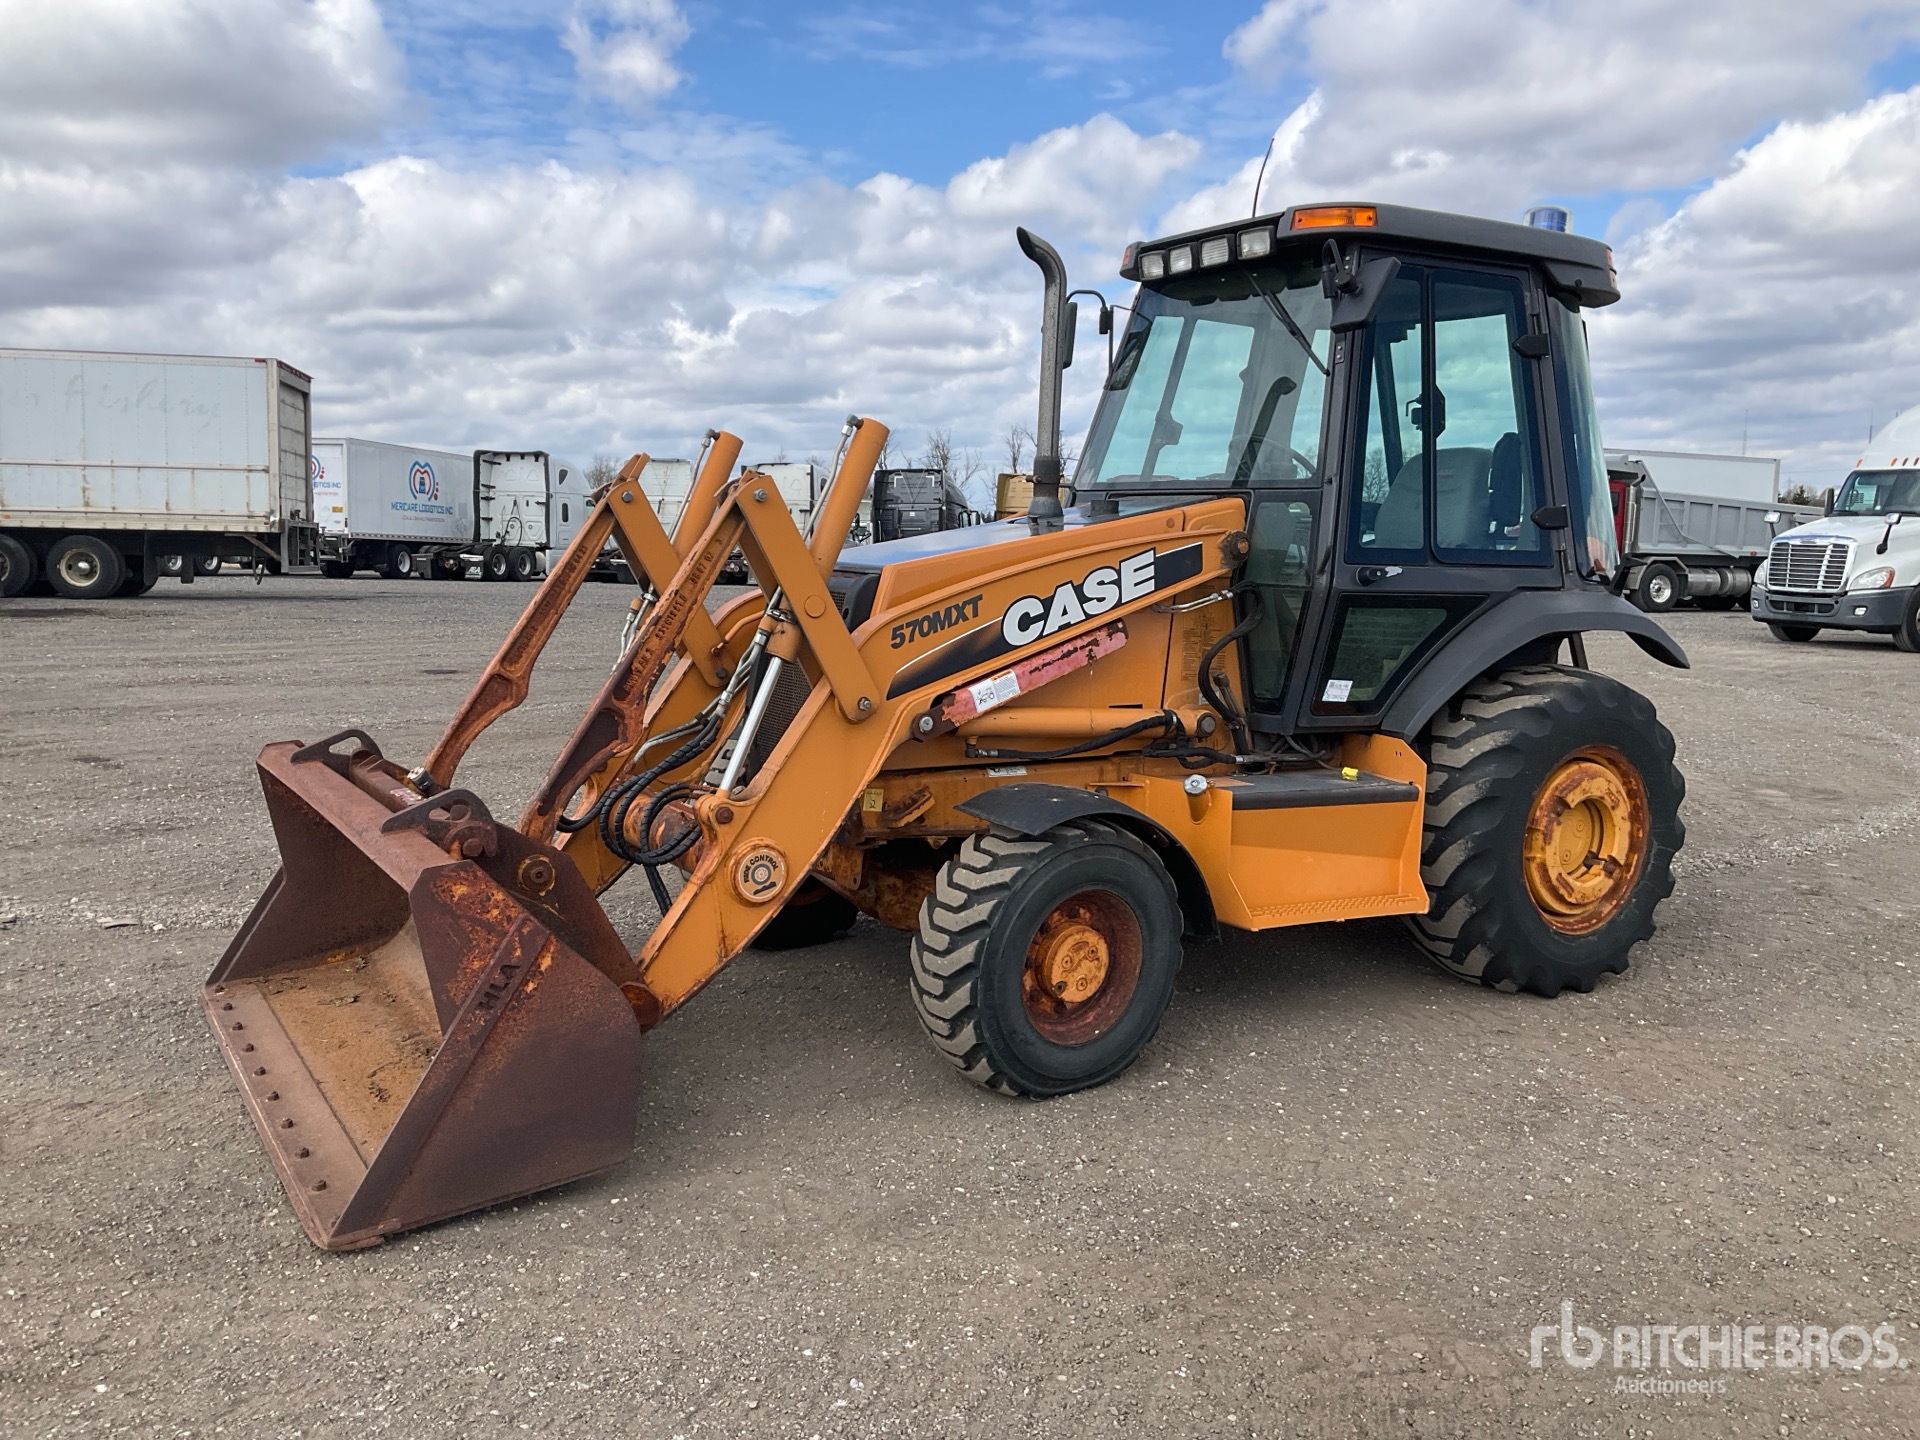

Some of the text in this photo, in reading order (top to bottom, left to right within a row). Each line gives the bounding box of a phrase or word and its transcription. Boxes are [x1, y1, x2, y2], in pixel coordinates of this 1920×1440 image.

[391, 501, 453, 515] MERICARE LOGISTICS INC
[1001, 548, 1155, 646] CASE
[890, 594, 983, 649] 570MXT
[750, 854, 779, 871] CONTROL
[477, 964, 521, 1003] HLA
